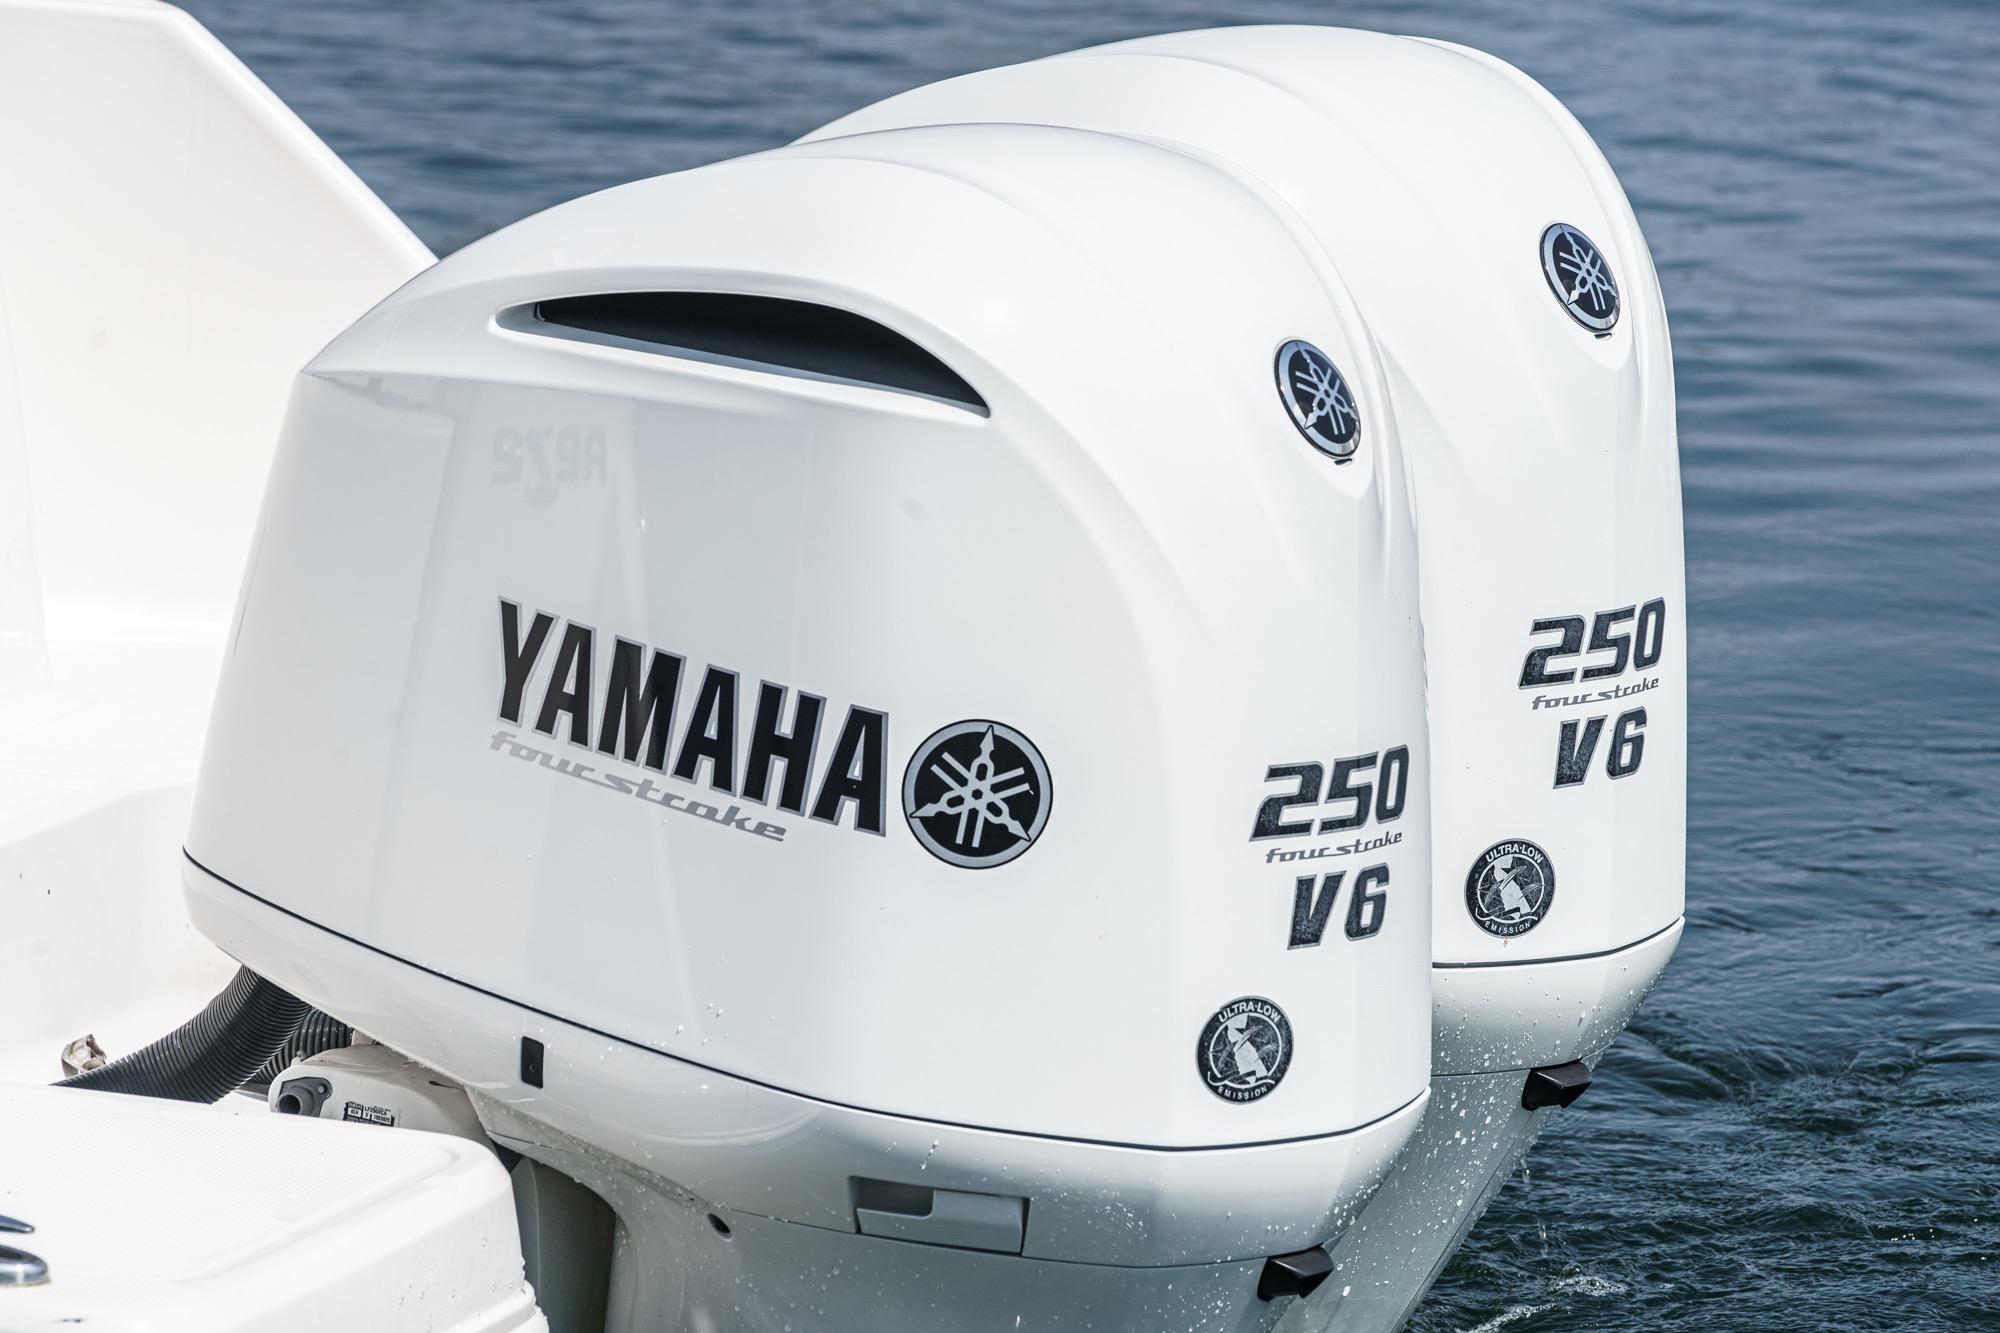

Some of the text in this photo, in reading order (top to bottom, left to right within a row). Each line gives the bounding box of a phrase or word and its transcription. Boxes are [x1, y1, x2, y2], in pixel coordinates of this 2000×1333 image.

[1518, 597, 1665, 689] 250
[497, 595, 889, 837] YAMAHA
[1553, 706, 1648, 789] V6
[1249, 744, 1410, 842] 250
[1287, 862, 1390, 951] V6
[1484, 920, 1531, 934] EMISSION
[1218, 1085, 1268, 1100] EMISSION
